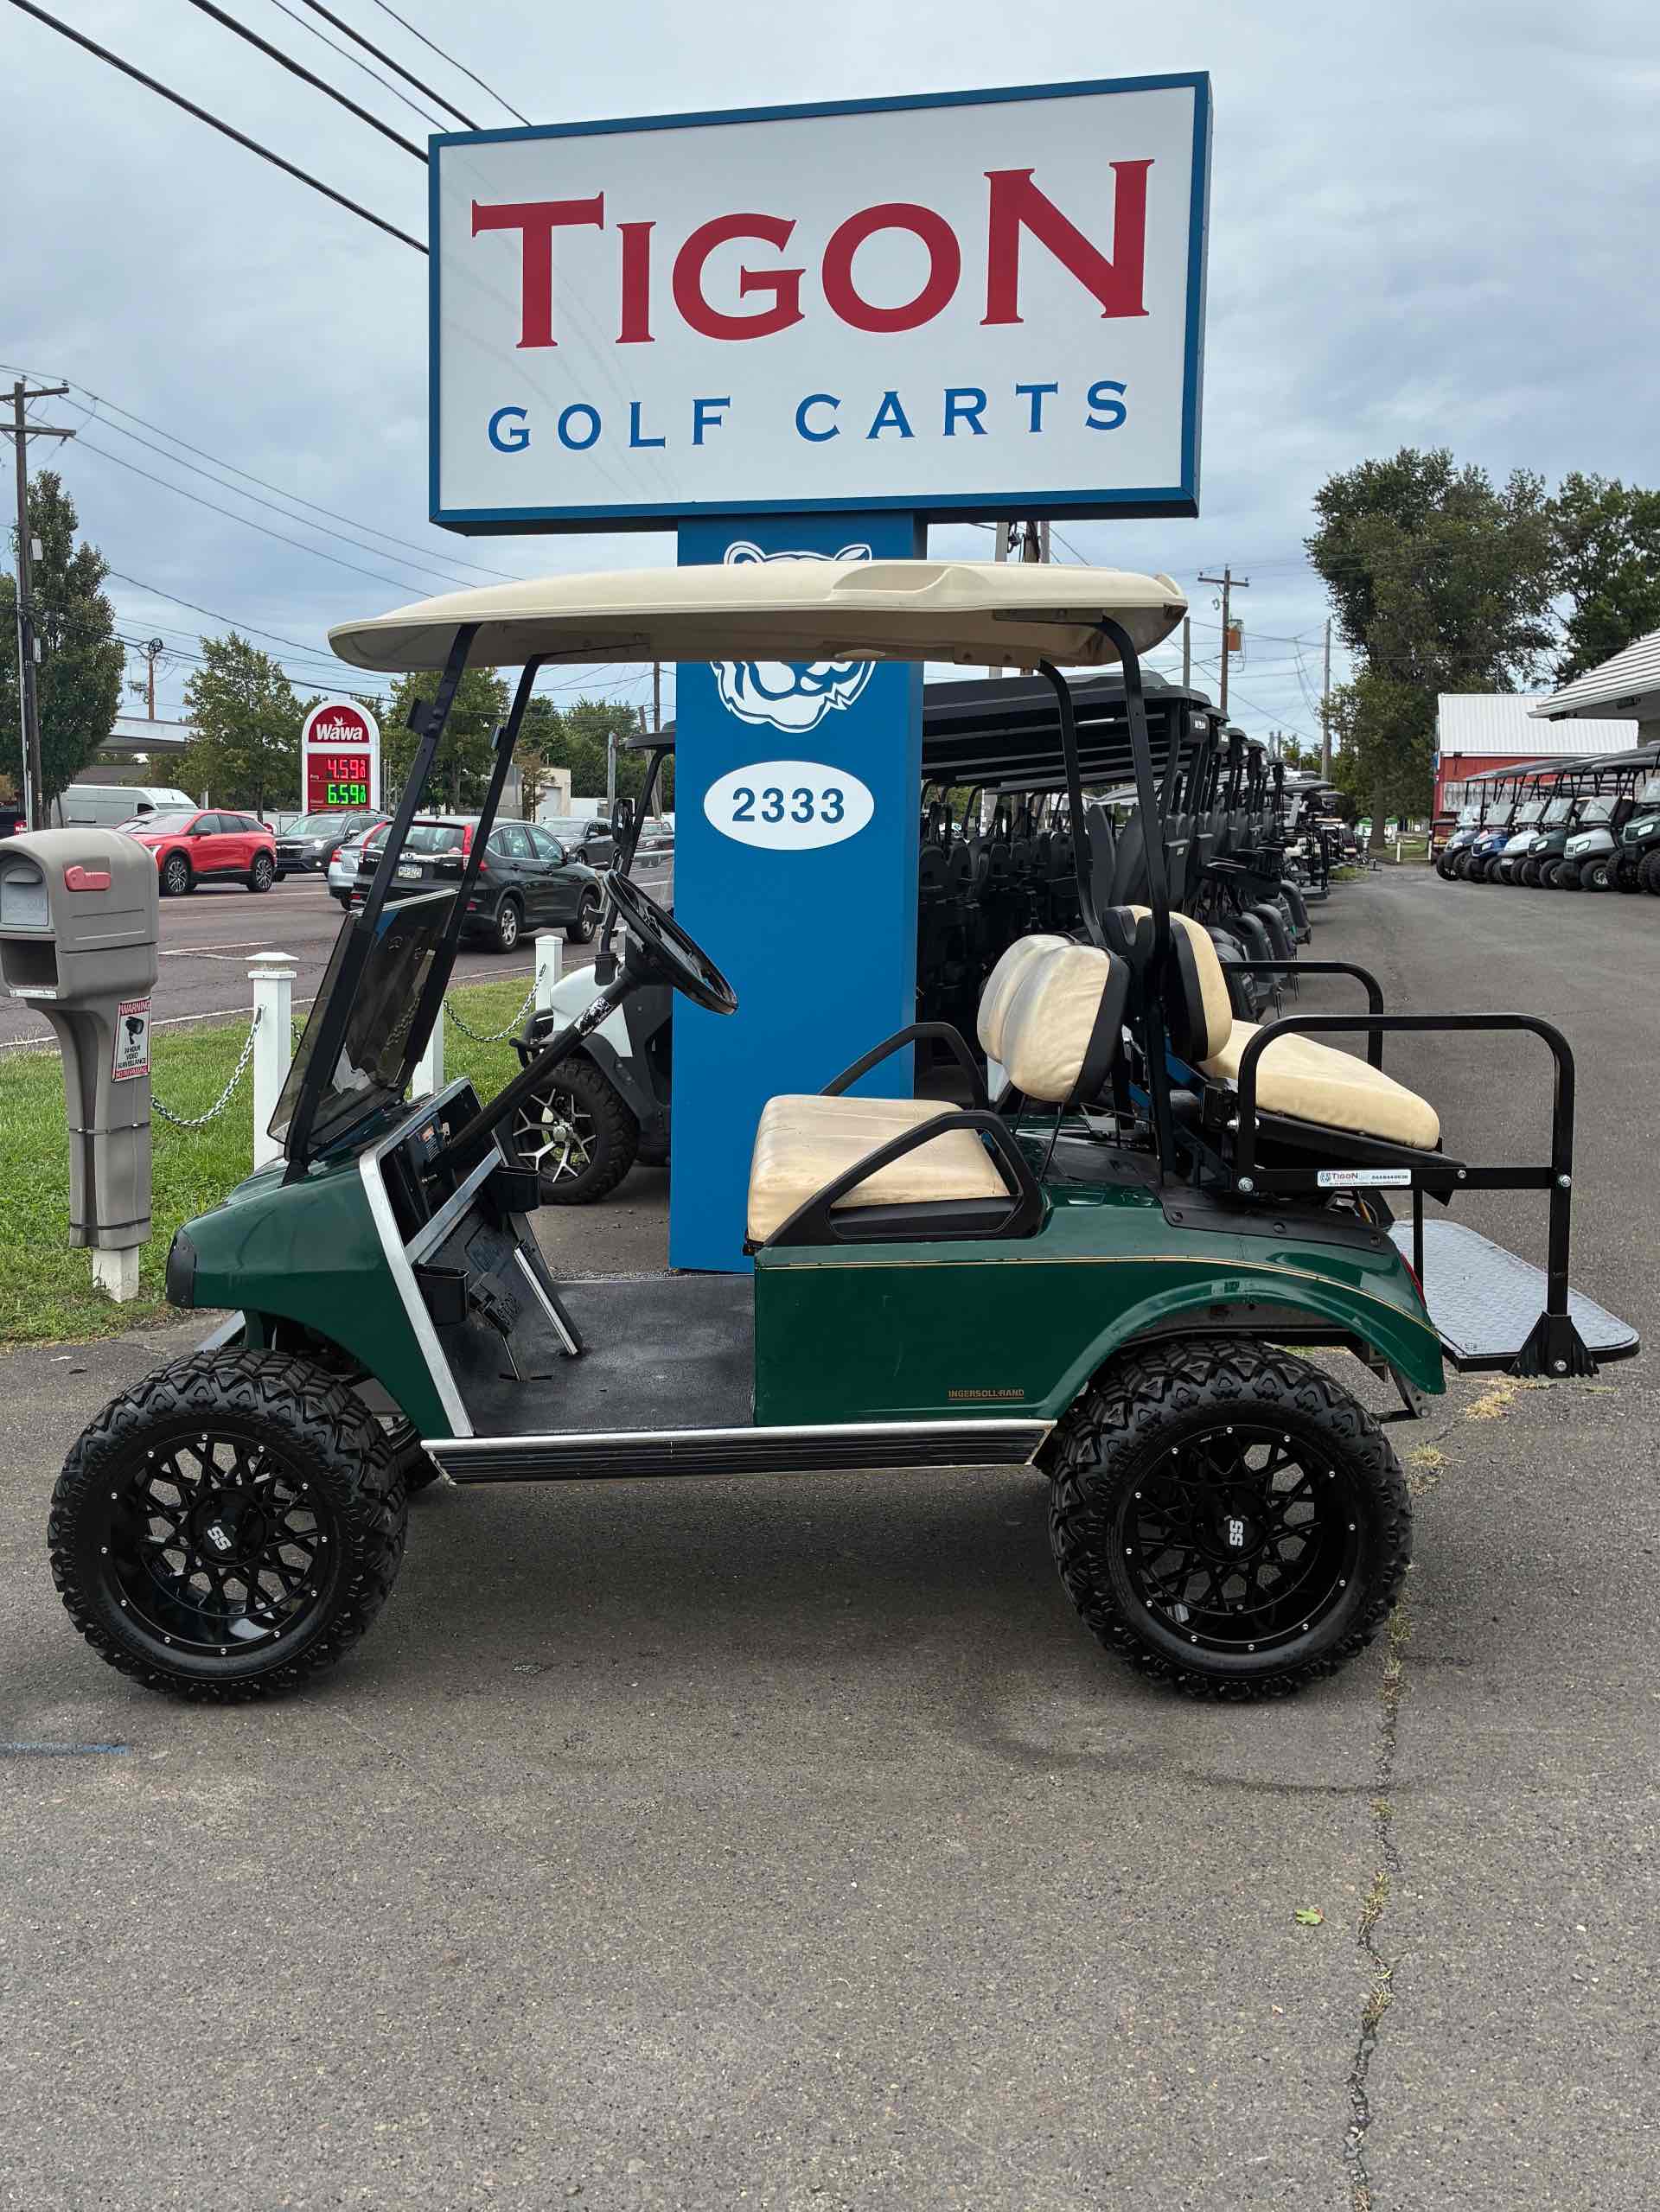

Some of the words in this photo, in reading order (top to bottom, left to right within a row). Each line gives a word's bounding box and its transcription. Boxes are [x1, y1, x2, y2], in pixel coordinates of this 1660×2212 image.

[471, 158, 1155, 348] TIGON
[488, 395, 731, 453] GOLF
[795, 380, 1128, 442] CARTS
[316, 724, 363, 740] Wawa
[731, 787, 845, 824] 2333
[121, 1000, 150, 1015] WARNING
[948, 1388, 1025, 1398] INGERSOLL-RAND
